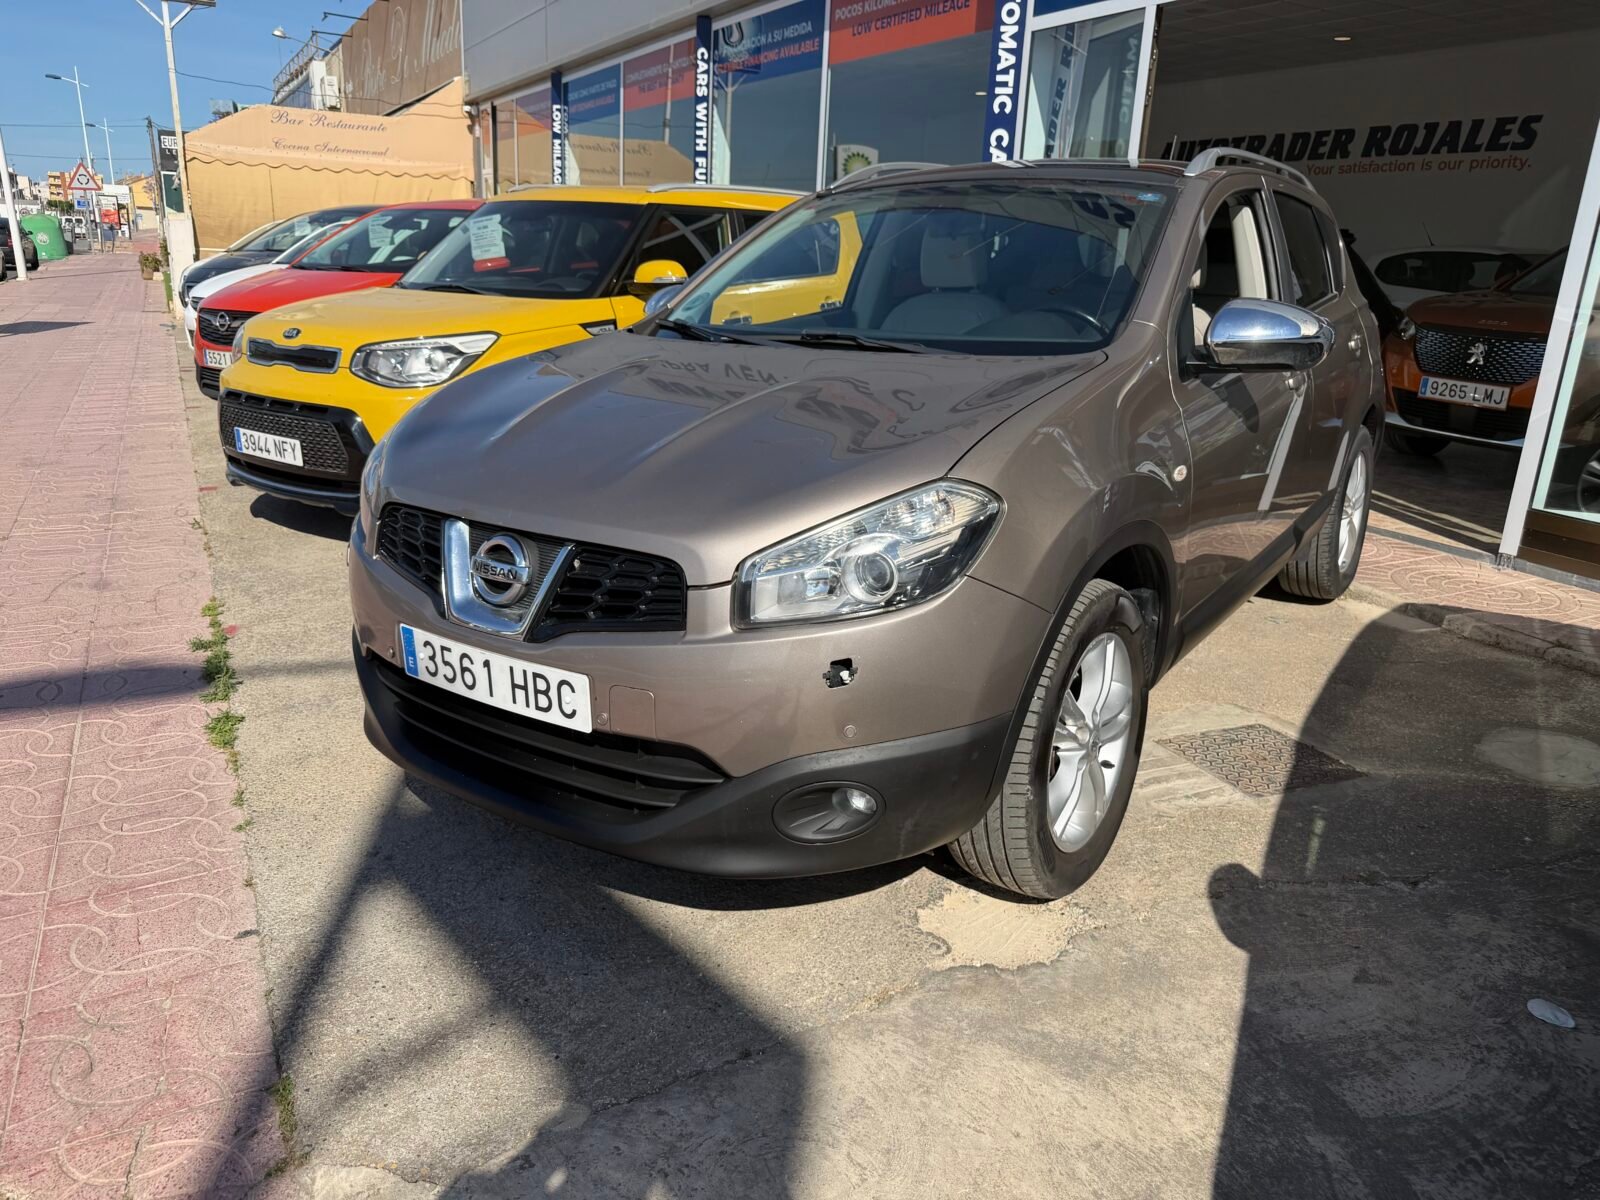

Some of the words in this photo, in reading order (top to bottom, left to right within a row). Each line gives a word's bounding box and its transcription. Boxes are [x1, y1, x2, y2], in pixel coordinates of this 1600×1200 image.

[835, 5, 863, 20] POCOS
[864, 0, 908, 14] KILOME
[852, 21, 872, 36] LOW
[875, 8, 922, 30] CERTIFIED
[924, 0, 970, 18] MILEAGE
[774, 29, 783, 42] SU
[784, 20, 813, 39] MEDIDA
[779, 38, 820, 59] AVAILABLE
[992, 0, 1021, 115] OMATIC
[696, 47, 709, 97] CARS
[271, 110, 305, 126] Bar
[310, 113, 388, 132] Restaurante
[552, 104, 562, 134] LOW
[695, 102, 708, 152] WITH
[272, 137, 310, 152] Cocina
[314, 141, 390, 157] Internacional
[989, 128, 1010, 163] CA
[1360, 114, 1545, 158] ROJALES
[552, 139, 562, 185] MILEAG
[694, 157, 708, 185] FU
[1306, 162, 1334, 176] Your
[1337, 159, 1415, 176] satisfaction
[1420, 158, 1433, 171] is
[1438, 159, 1465, 172] our
[1469, 154, 1532, 172] priority.
[207, 351, 229, 366] 5521
[1429, 380, 1469, 400] 9265
[1471, 386, 1506, 405] LMJ
[242, 432, 271, 456] 3944
[273, 438, 297, 461] NFY
[473, 560, 518, 580] NISSAN
[423, 640, 494, 698] 3561
[509, 665, 577, 720] HBC
